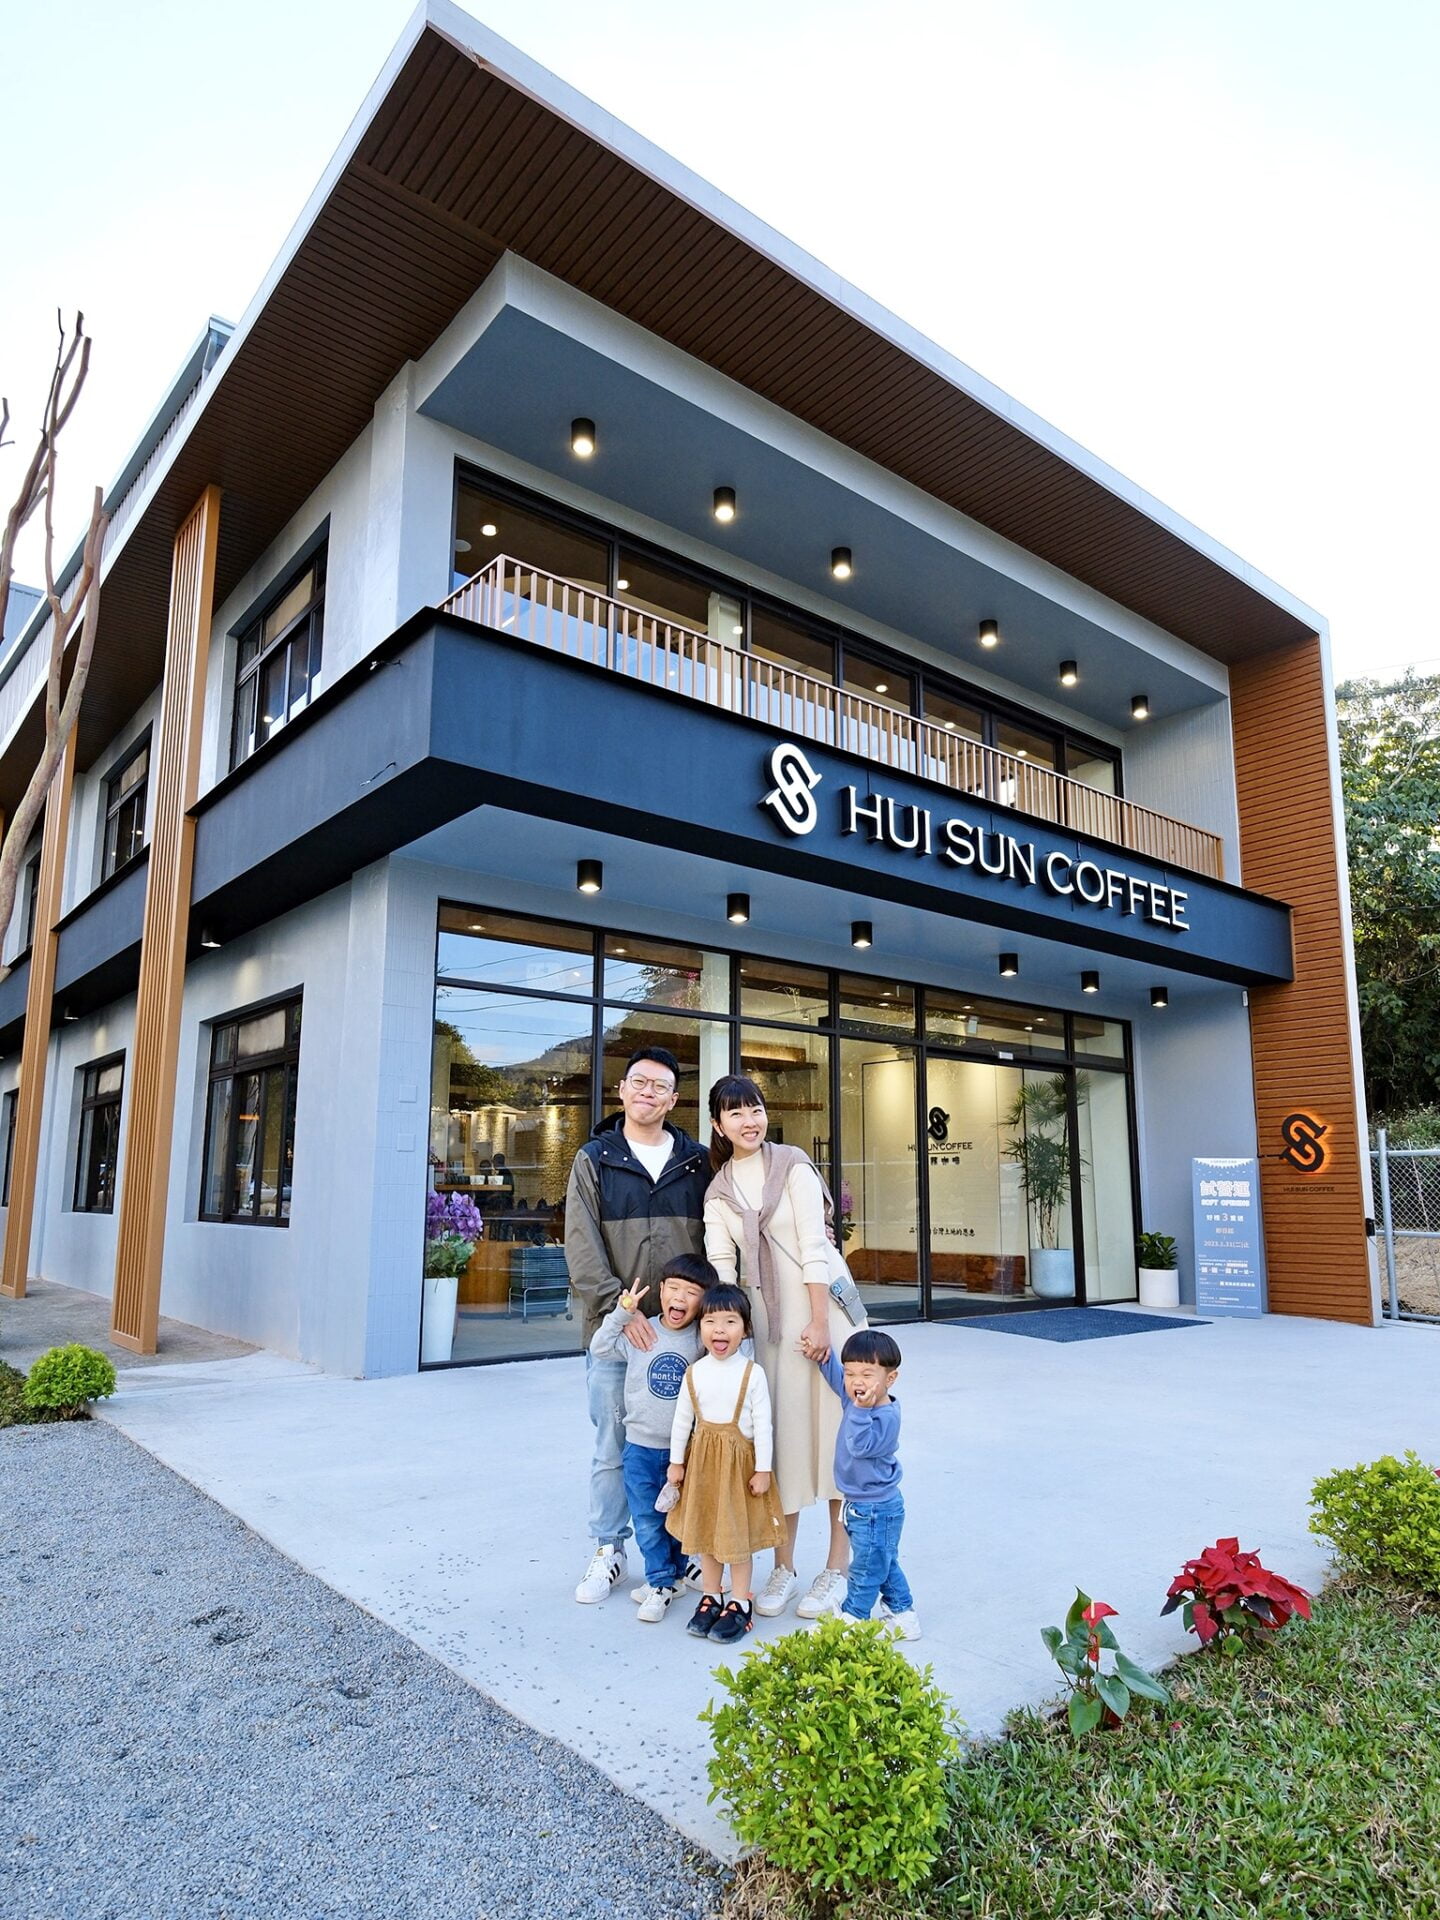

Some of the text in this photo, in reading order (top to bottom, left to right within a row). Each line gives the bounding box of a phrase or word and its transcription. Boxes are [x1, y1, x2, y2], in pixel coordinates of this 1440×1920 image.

[846, 785, 1190, 931] HUI SUN COFFEE
[940, 1142, 973, 1151] COFFEE
[1200, 1180, 1250, 1198] 試營運
[652, 1372, 681, 1382] mont-be
